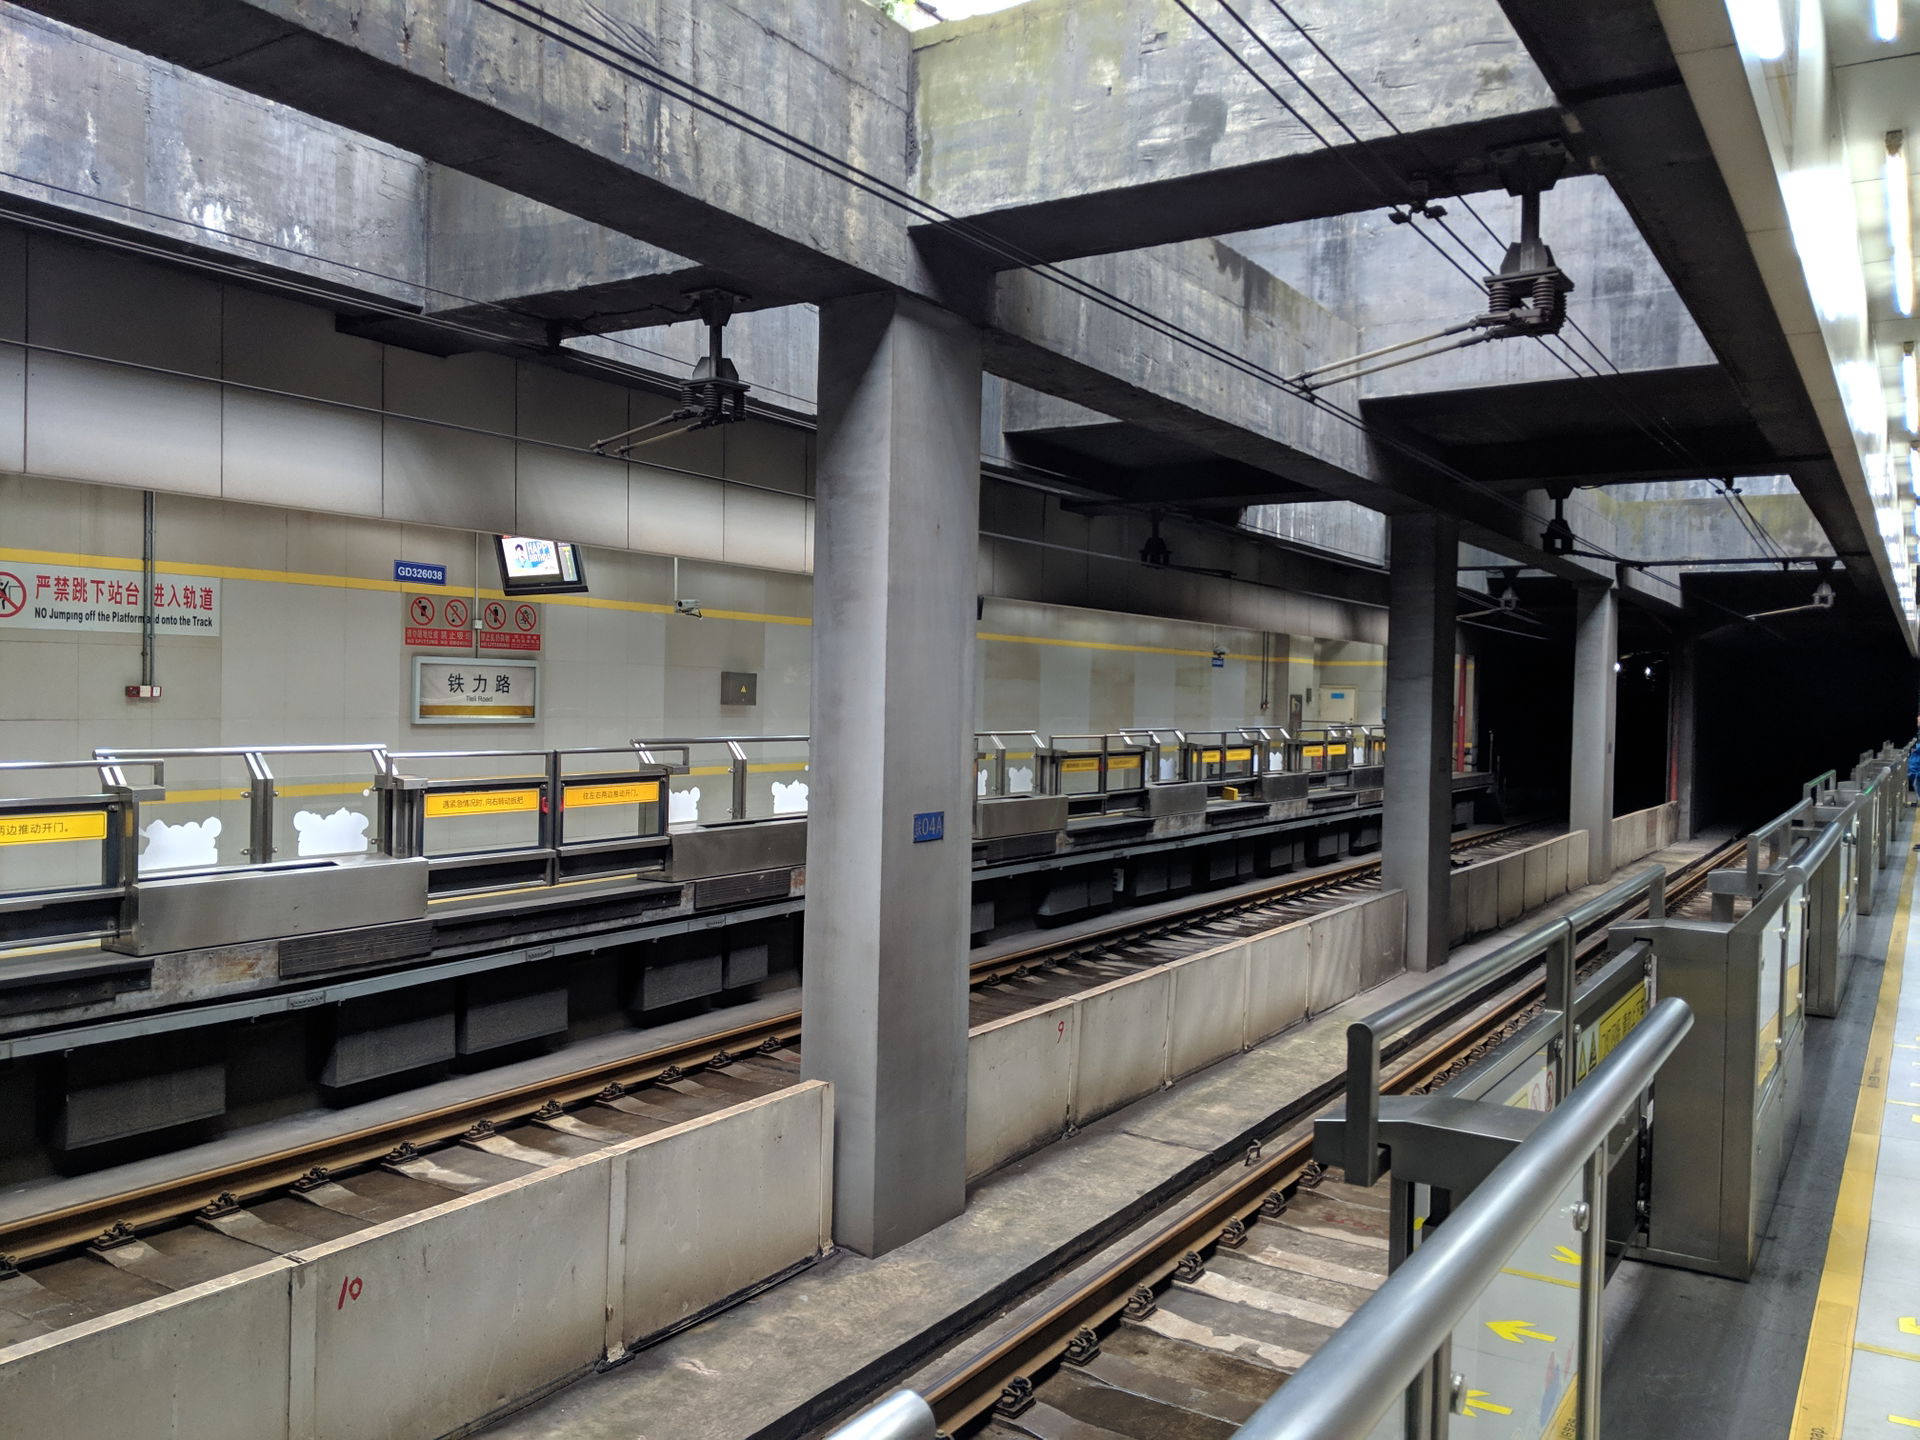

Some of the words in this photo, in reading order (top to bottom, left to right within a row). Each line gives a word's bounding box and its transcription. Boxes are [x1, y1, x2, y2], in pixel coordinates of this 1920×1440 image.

[397, 566, 443, 581] GD326038
[34, 607, 47, 619] NO
[49, 608, 83, 623] Jumping
[85, 610, 96, 621] off
[98, 611, 111, 622] the
[161, 615, 178, 626] onto
[179, 615, 191, 627] the
[192, 616, 213, 628] Track
[448, 673, 511, 693] 铁力路
[478, 695, 493, 703] Road
[1057, 1020, 1065, 1044] 9
[338, 1275, 364, 1311] 10
